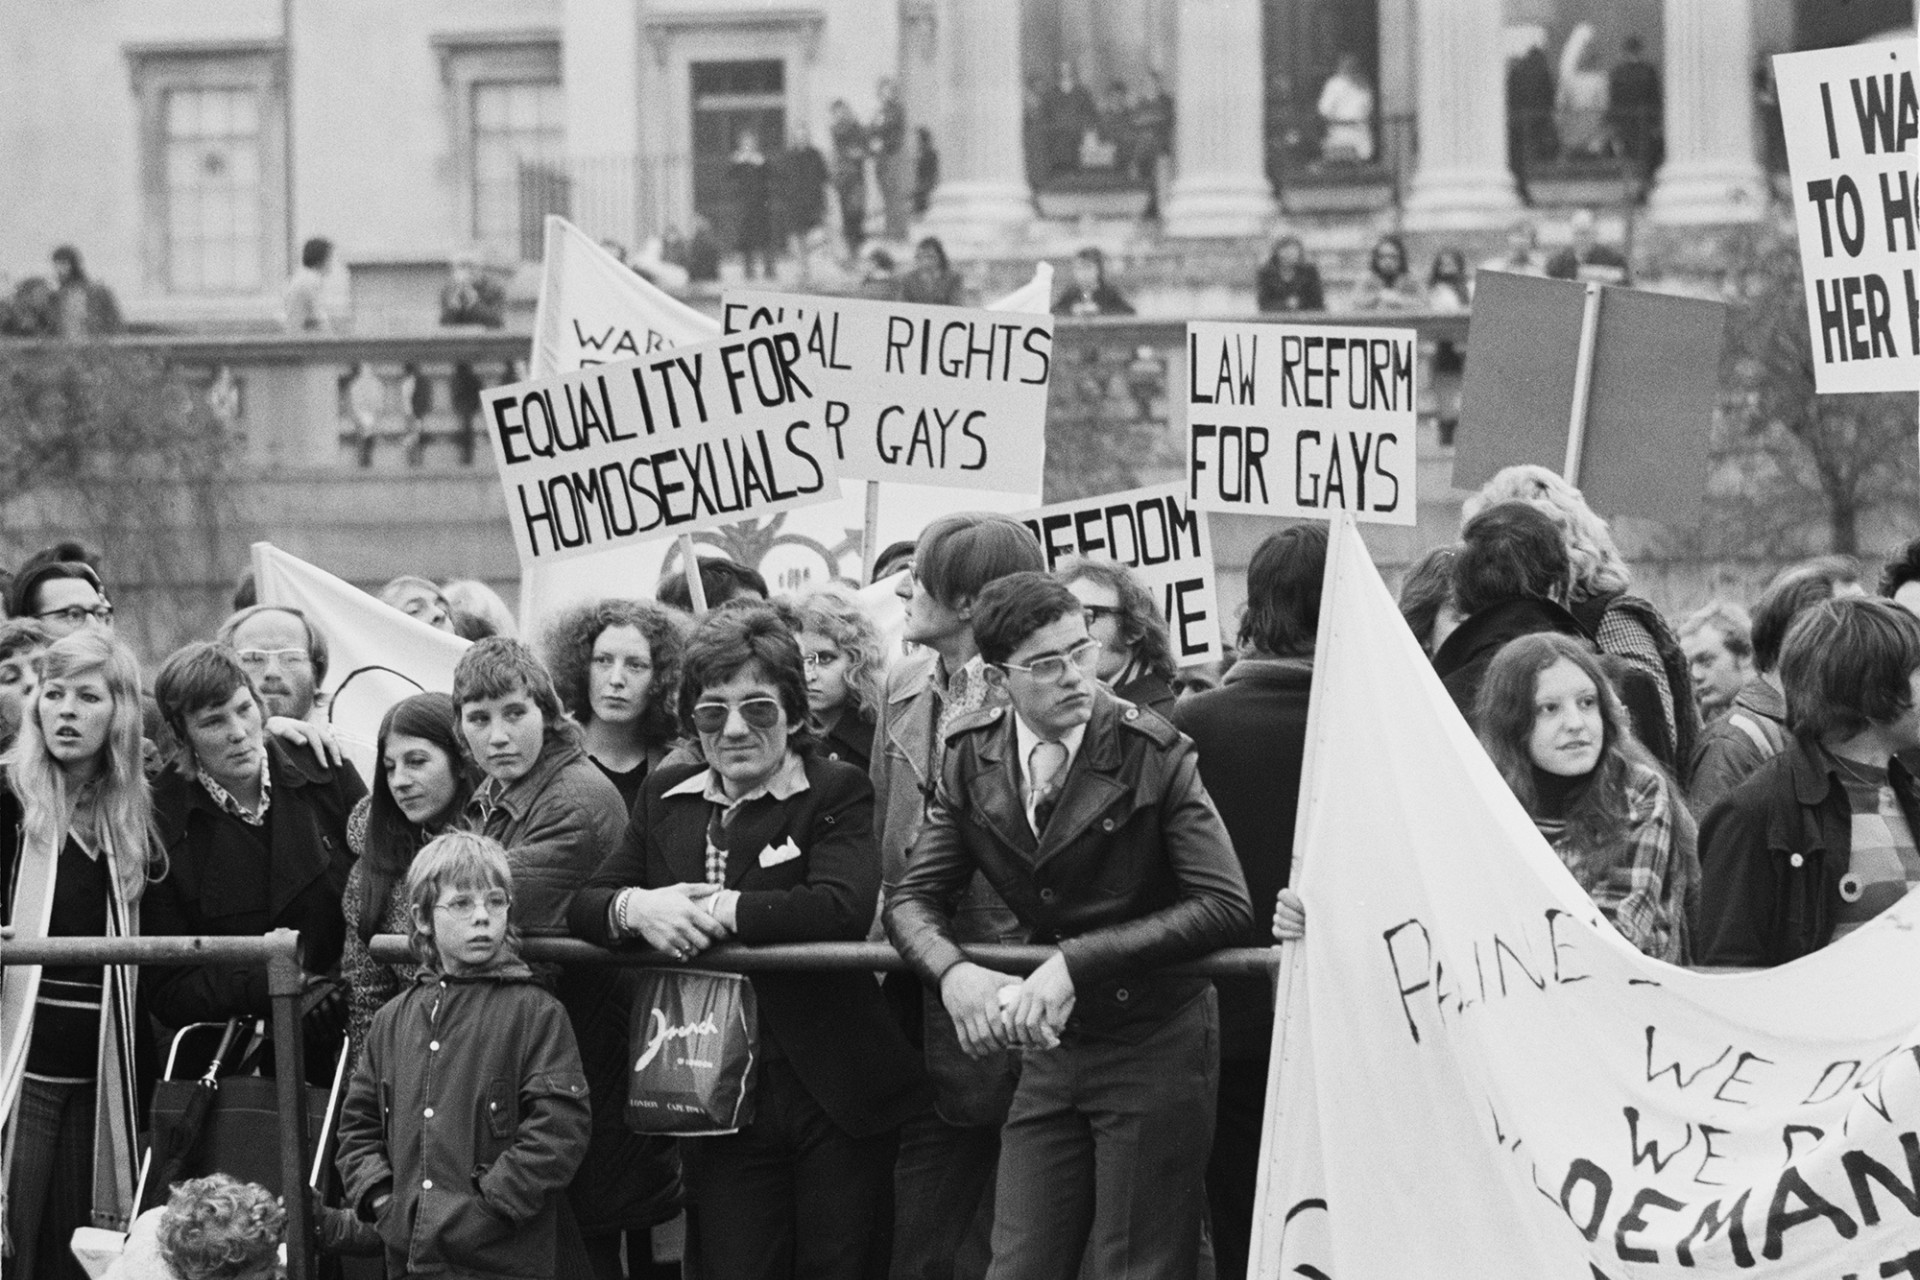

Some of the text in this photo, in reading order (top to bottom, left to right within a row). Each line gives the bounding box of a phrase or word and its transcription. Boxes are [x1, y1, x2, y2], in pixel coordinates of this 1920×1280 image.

[1820, 81, 1840, 159] I
[1807, 170, 1919, 257] TO H
[573, 318, 675, 355] WAR
[886, 315, 1052, 385] RIGHTS
[1816, 273, 1899, 363] HER
[493, 352, 708, 465] EQUALITY
[720, 331, 813, 415] FOR
[1190, 332, 1413, 412] LAW REFORM
[876, 405, 987, 470] GAYS
[1191, 424, 1399, 512] FOR GAYS
[517, 420, 825, 557] HOMOSEXUALS
[1022, 495, 1201, 572] EEDOM
[1645, 1024, 1775, 1104] WE
[1623, 1106, 1732, 1187] WE
